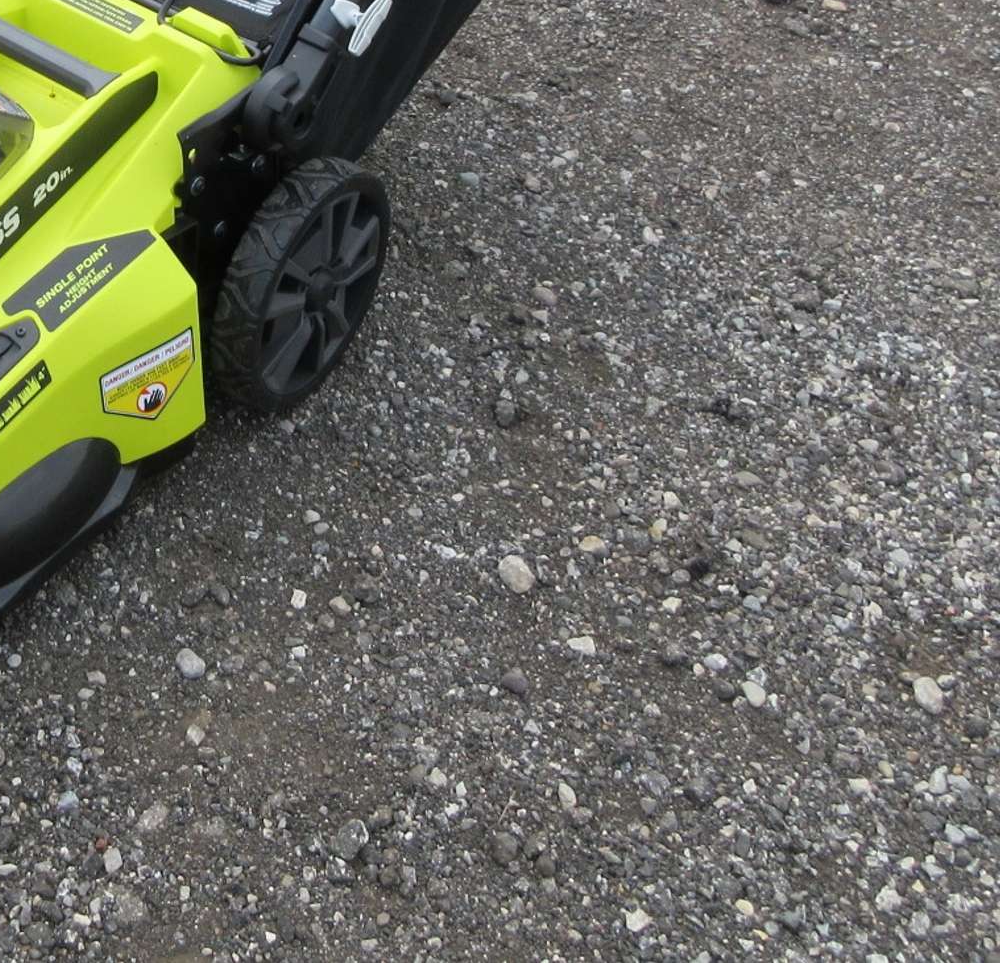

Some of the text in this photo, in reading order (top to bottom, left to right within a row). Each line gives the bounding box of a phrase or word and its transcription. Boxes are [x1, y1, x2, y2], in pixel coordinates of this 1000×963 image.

[36, 243, 108, 308] SINGLE POINT
[59, 262, 113, 313] ADJUSTMENT
[65, 268, 96, 298] HEIGHT
